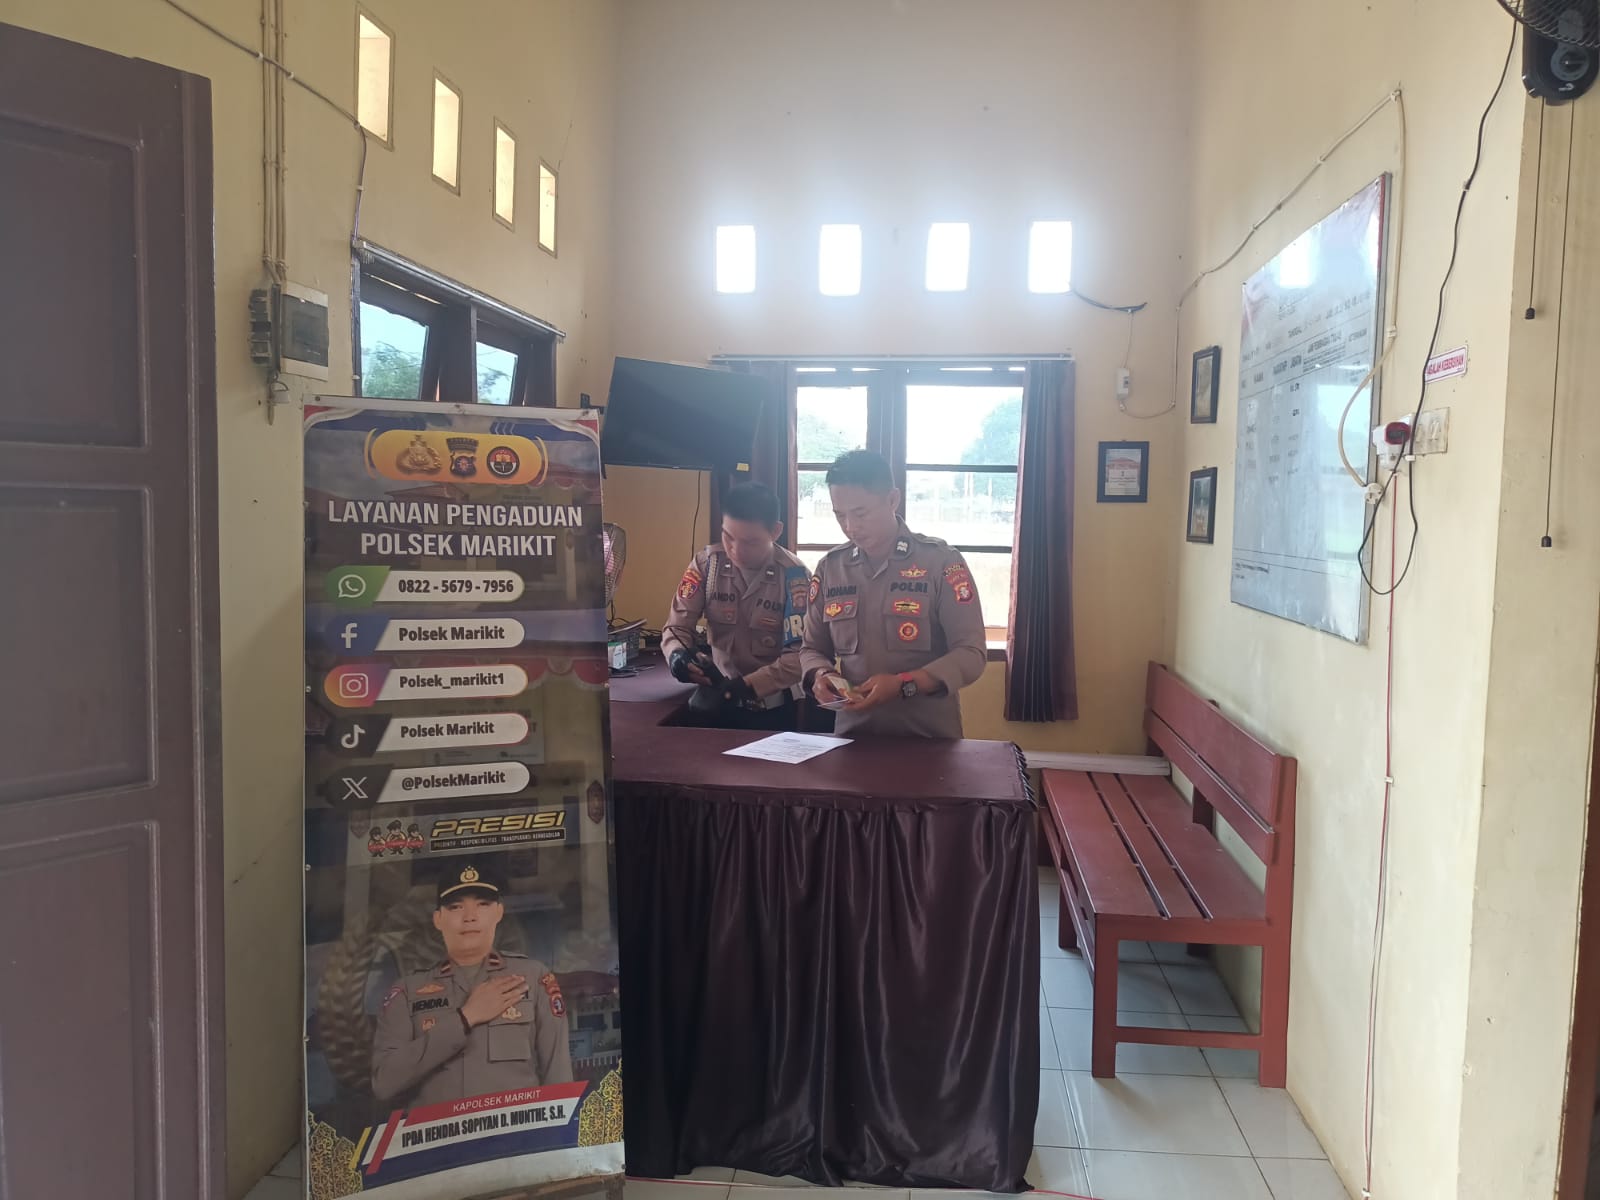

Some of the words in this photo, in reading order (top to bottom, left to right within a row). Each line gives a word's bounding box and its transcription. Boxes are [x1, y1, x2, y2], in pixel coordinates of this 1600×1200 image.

[328, 500, 438, 524] LAYANAN
[447, 504, 582, 527] PENGADUAN
[361, 533, 453, 555] POLSEK
[461, 535, 556, 556] MARIKIT
[398, 579, 430, 593] 0822
[441, 579, 473, 593] 5679
[483, 579, 514, 593] 7956
[890, 582, 928, 593] POLRI
[399, 627, 447, 642] Polsek
[451, 625, 505, 641] Marikit
[400, 673, 504, 689] Polsek_marikit1
[401, 724, 443, 738] Polsek
[446, 721, 494, 736] Marikit
[402, 772, 506, 791] @PolsekMarikit
[431, 811, 565, 837] PRESISI
[412, 998, 449, 1013] HENDRA
[453, 1097, 502, 1112] KAPOLSEK
[504, 1089, 541, 1104] MARIKIT
[402, 1131, 424, 1148] IPDA
[424, 1125, 460, 1143] HENDRA
[461, 1114, 499, 1134] SOPIYAN
[500, 1113, 509, 1128] D.
[510, 1106, 548, 1125] MUNTHE,
[549, 1105, 566, 1120] S.H.
